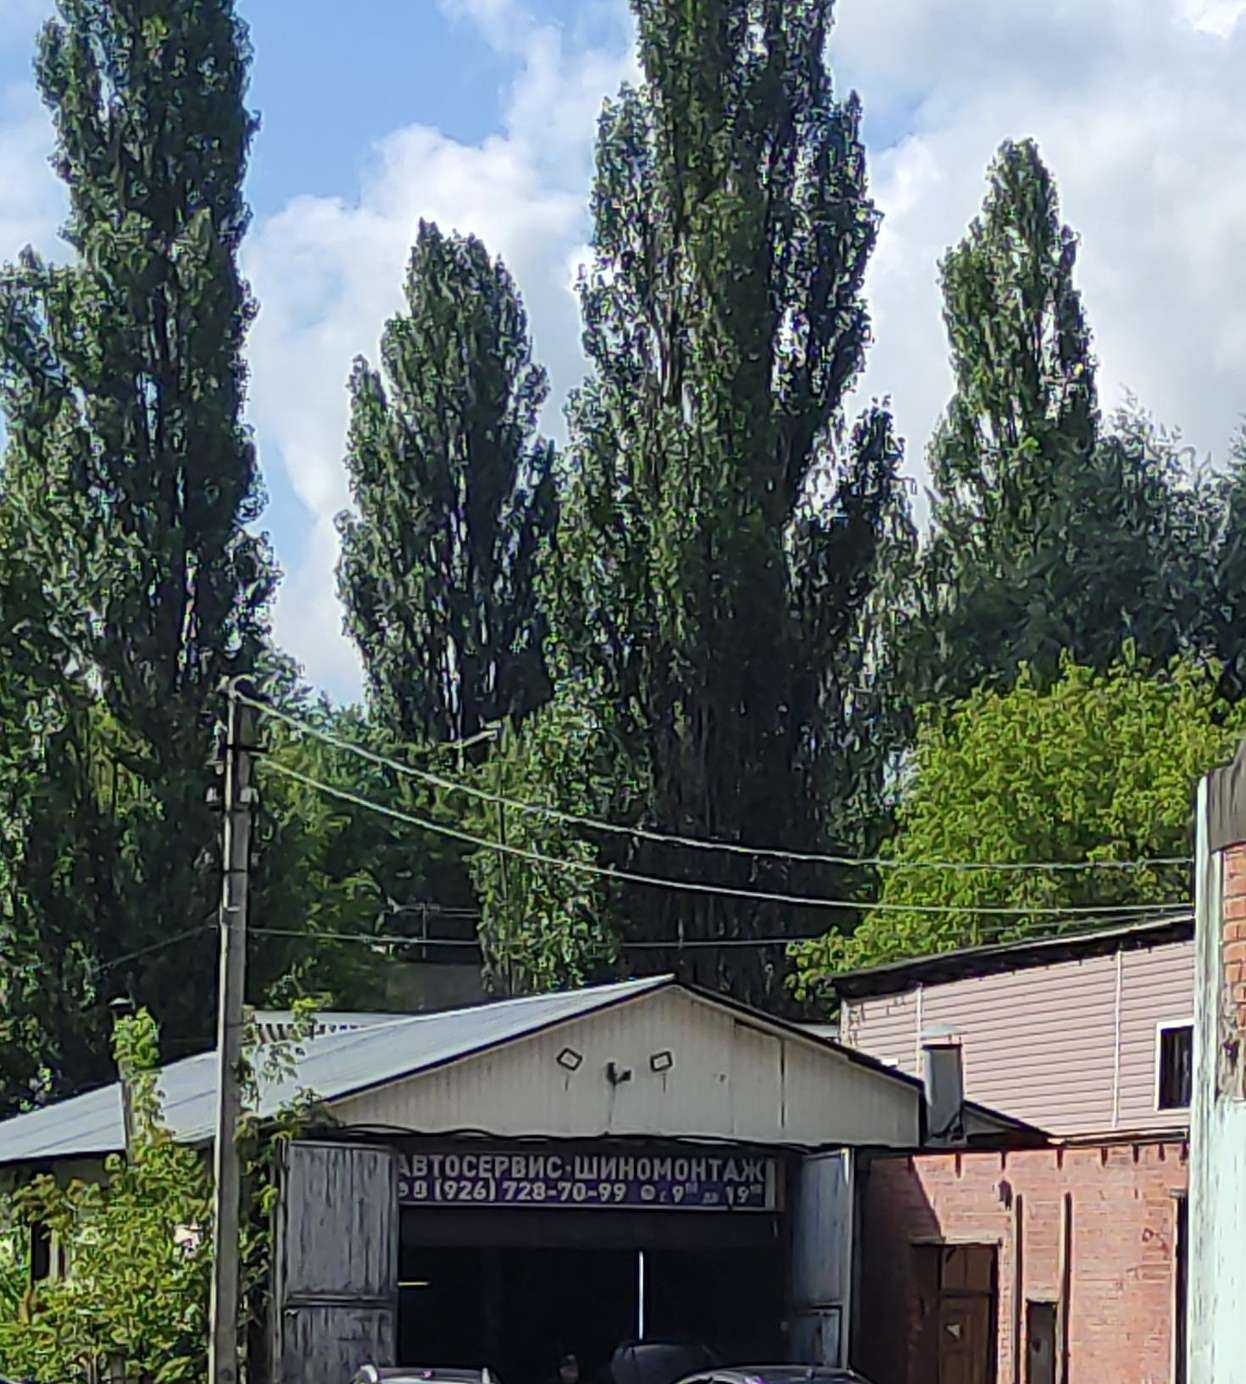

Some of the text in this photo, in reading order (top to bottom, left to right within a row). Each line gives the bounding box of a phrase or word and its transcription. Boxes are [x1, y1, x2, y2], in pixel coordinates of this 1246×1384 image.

[398, 1154, 765, 1182] АВТОСЕРВИС ШИНОМОНТАЖ
[413, 1180, 428, 1199] 8
[434, 1178, 496, 1201] (926)
[502, 1180, 627, 1202] 728-70-99
